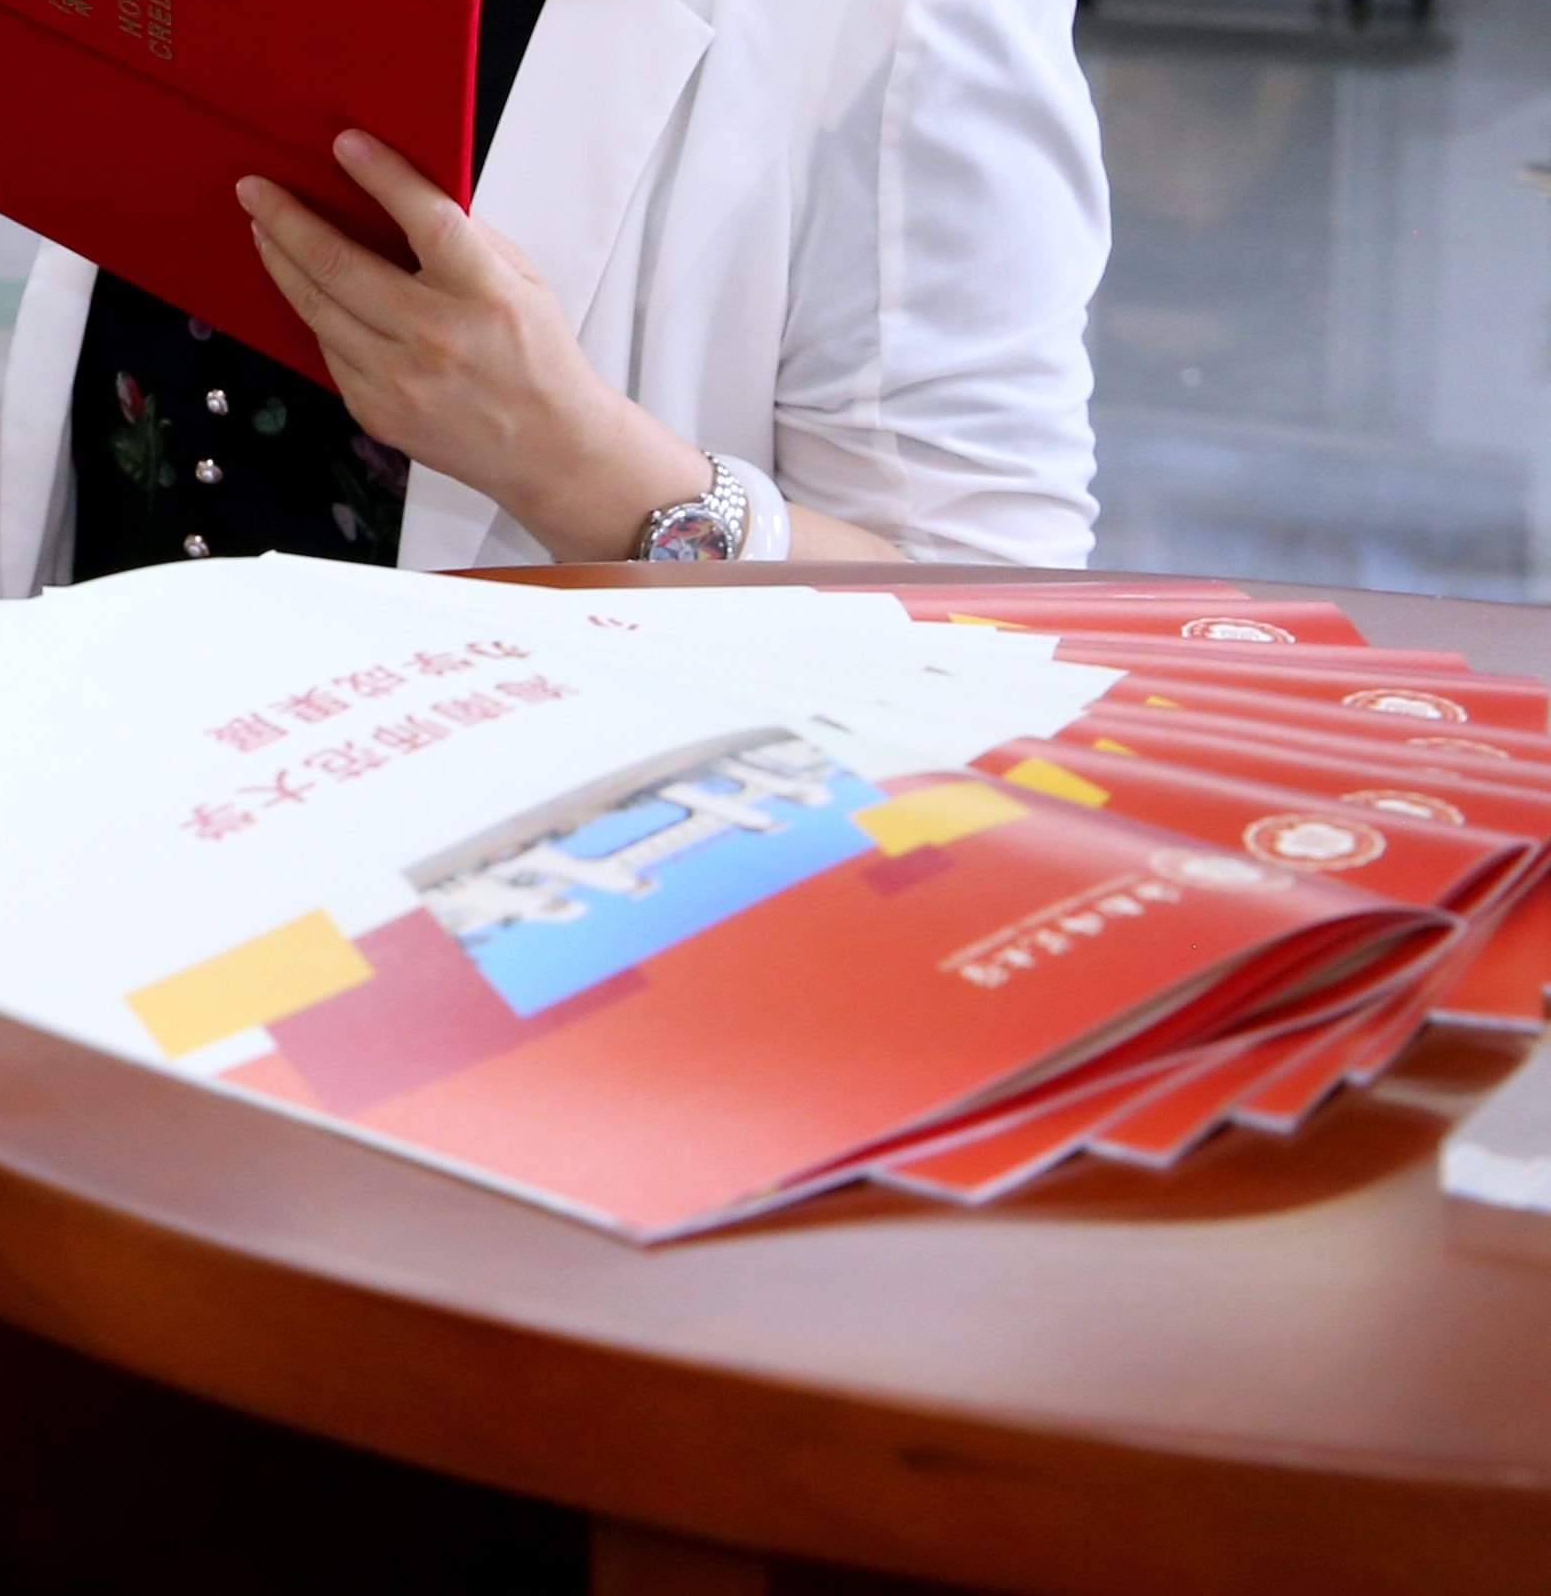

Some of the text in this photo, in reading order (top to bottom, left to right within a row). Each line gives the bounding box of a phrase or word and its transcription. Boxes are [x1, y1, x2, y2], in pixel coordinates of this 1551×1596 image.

[179, 672, 583, 842] 海南师范大学
[204, 638, 533, 755] 办学成果展
